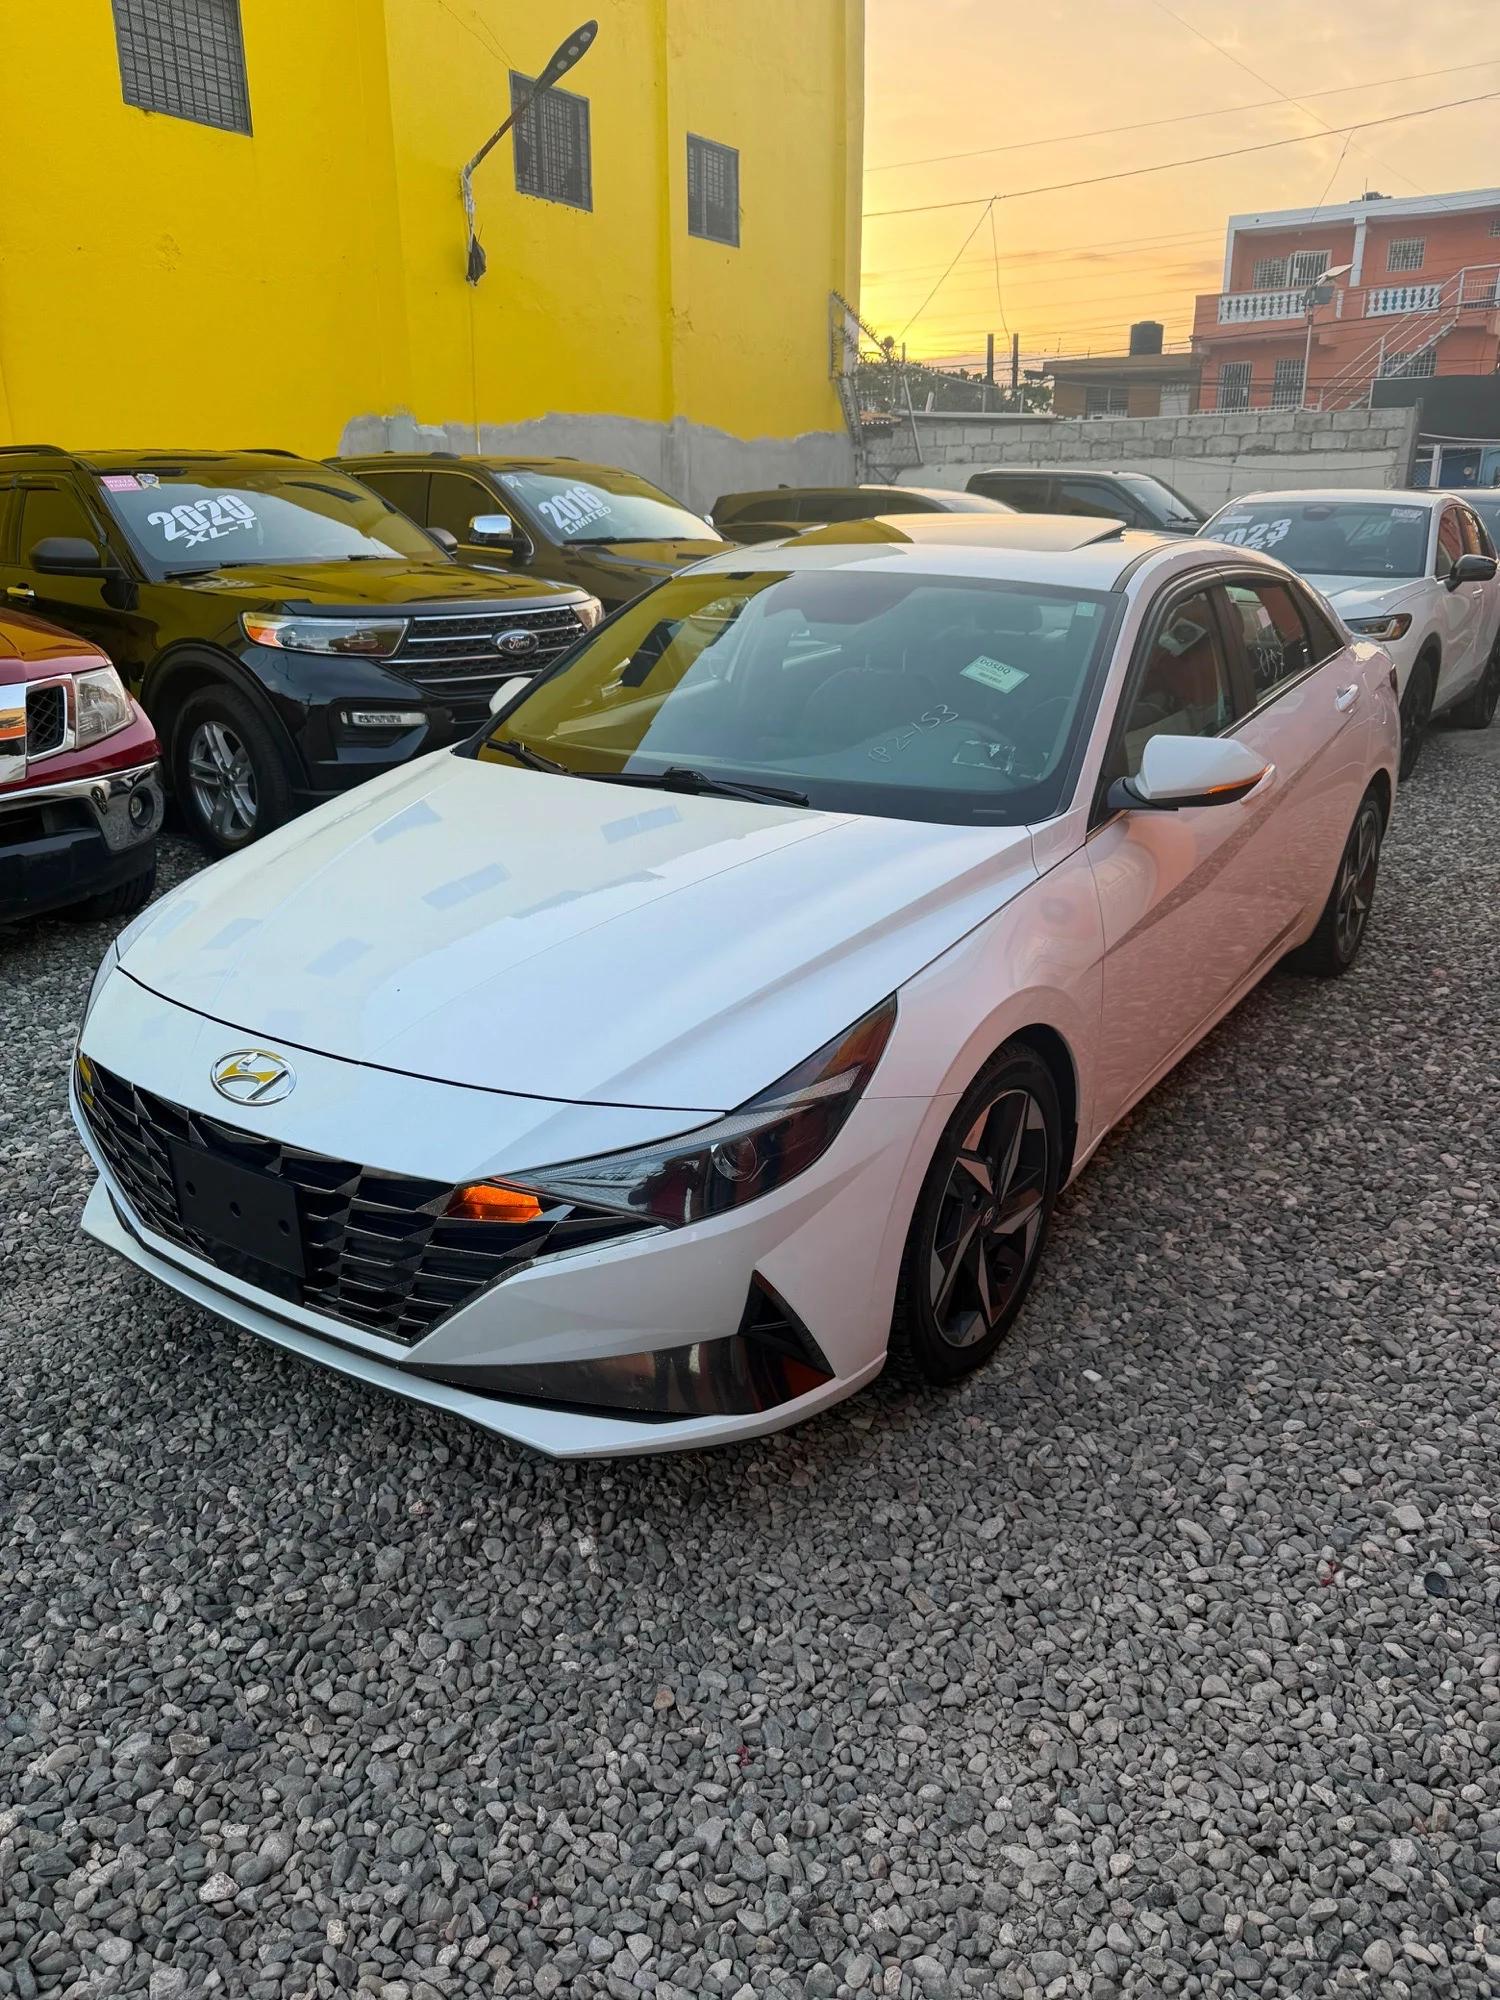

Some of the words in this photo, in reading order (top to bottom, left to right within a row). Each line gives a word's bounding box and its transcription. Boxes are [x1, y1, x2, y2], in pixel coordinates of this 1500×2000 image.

[147, 494, 255, 541] 2020
[538, 486, 603, 529] 2016
[564, 506, 612, 535] LIMITED
[509, 635, 530, 649] Ford
